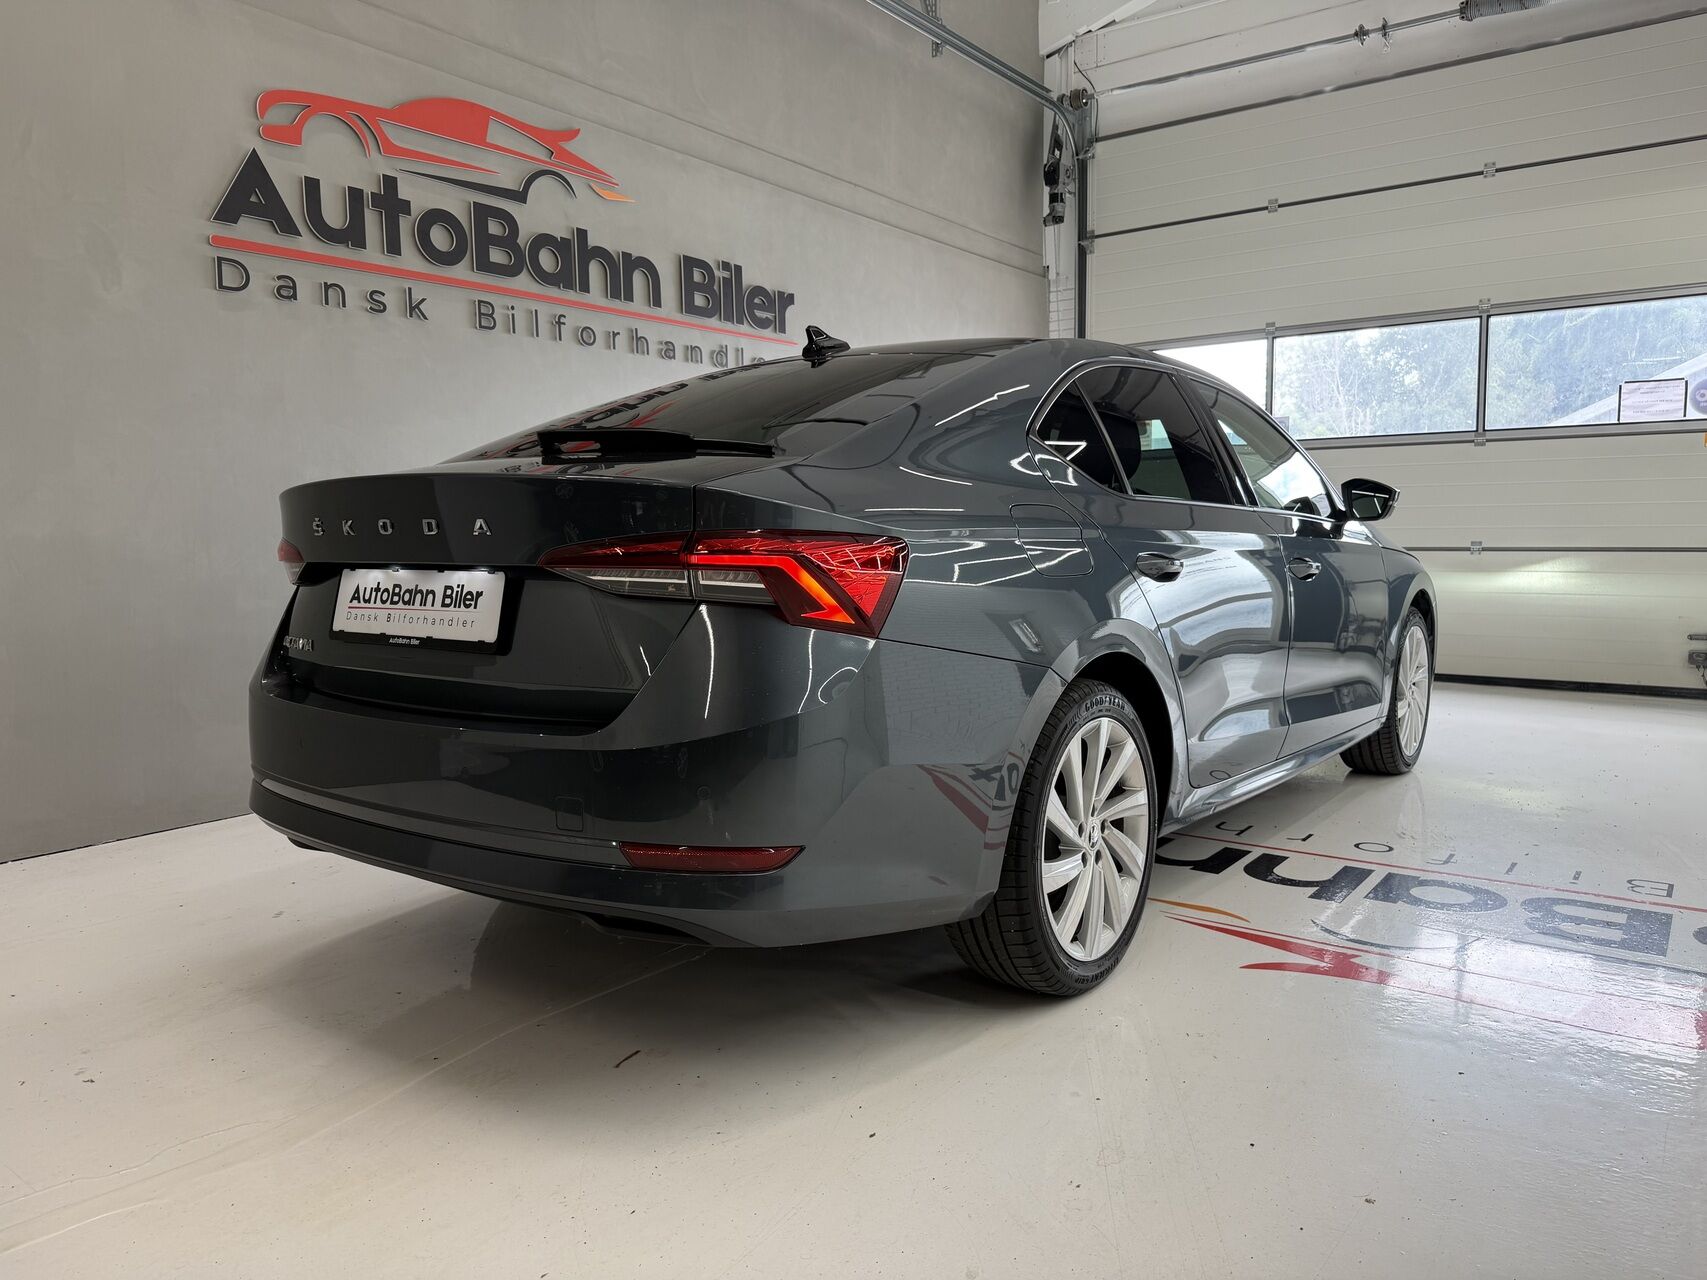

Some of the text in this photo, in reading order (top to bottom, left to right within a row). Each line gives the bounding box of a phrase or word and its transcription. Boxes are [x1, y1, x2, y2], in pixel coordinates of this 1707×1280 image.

[210, 146, 796, 335] AutoBahn Biler
[213, 256, 430, 322] Dansk
[311, 517, 492, 536] ŠKODA
[349, 581, 484, 610] AutoBahn Biler
[346, 610, 476, 629] Dansk Bilforhandler
[389, 637, 410, 645] AutoBahn
[1084, 695, 1127, 712] GOODYEAR
